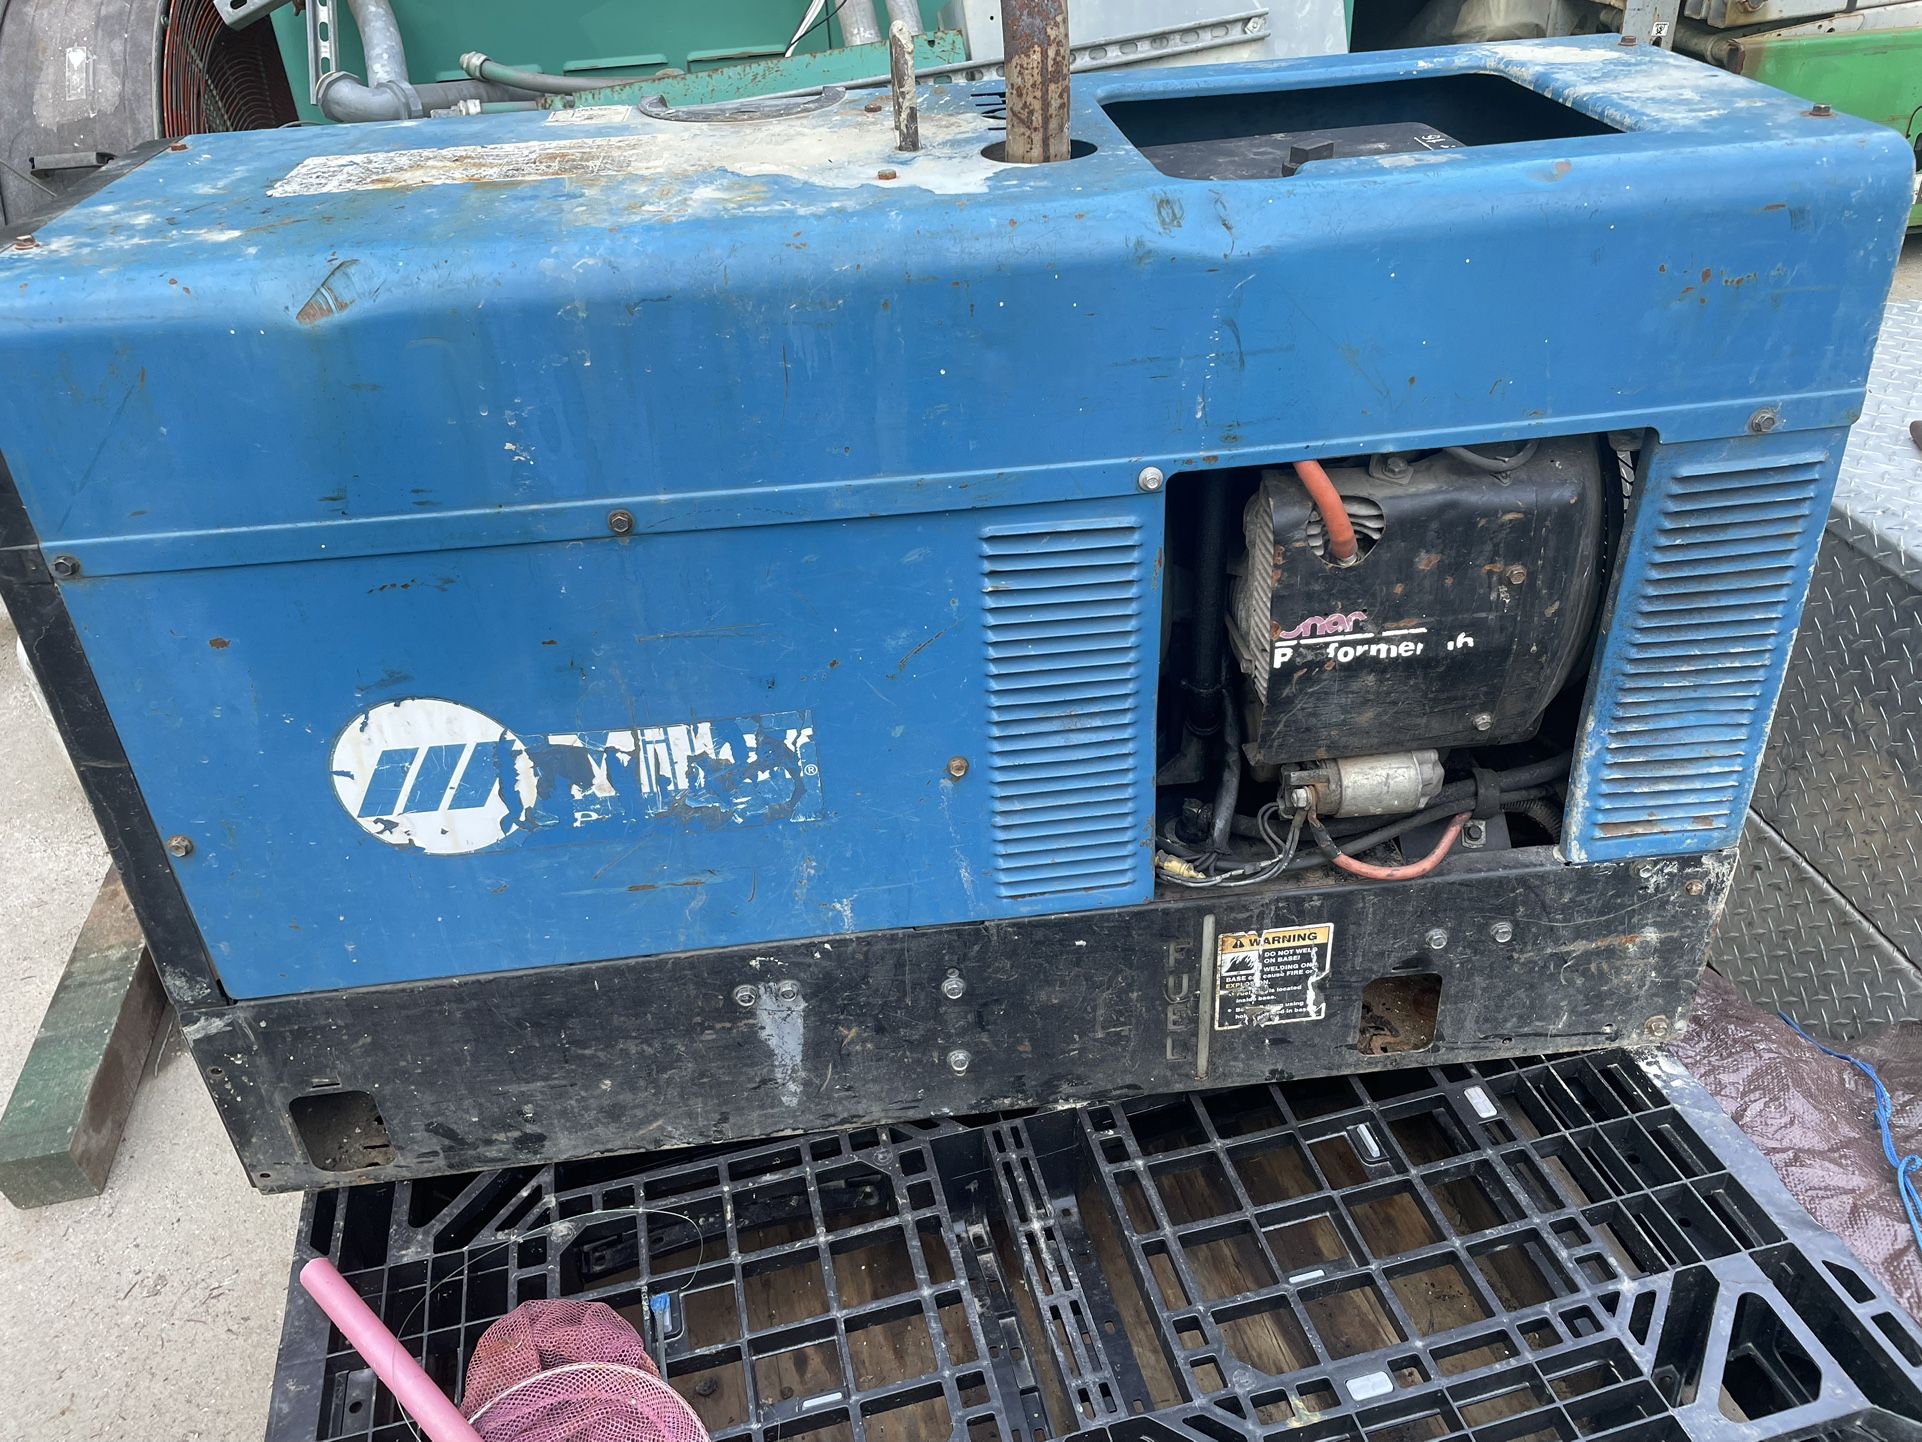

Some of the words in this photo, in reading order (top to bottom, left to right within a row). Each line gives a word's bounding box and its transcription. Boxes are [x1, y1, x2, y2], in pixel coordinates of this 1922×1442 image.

[1249, 932, 1318, 947] WARNING
[1264, 963, 1299, 972] WELDING
[1225, 975, 1247, 983] BASE
[1286, 968, 1304, 976] FIRE
[1276, 984, 1302, 992] located
[1166, 939, 1193, 1063] FUEL
